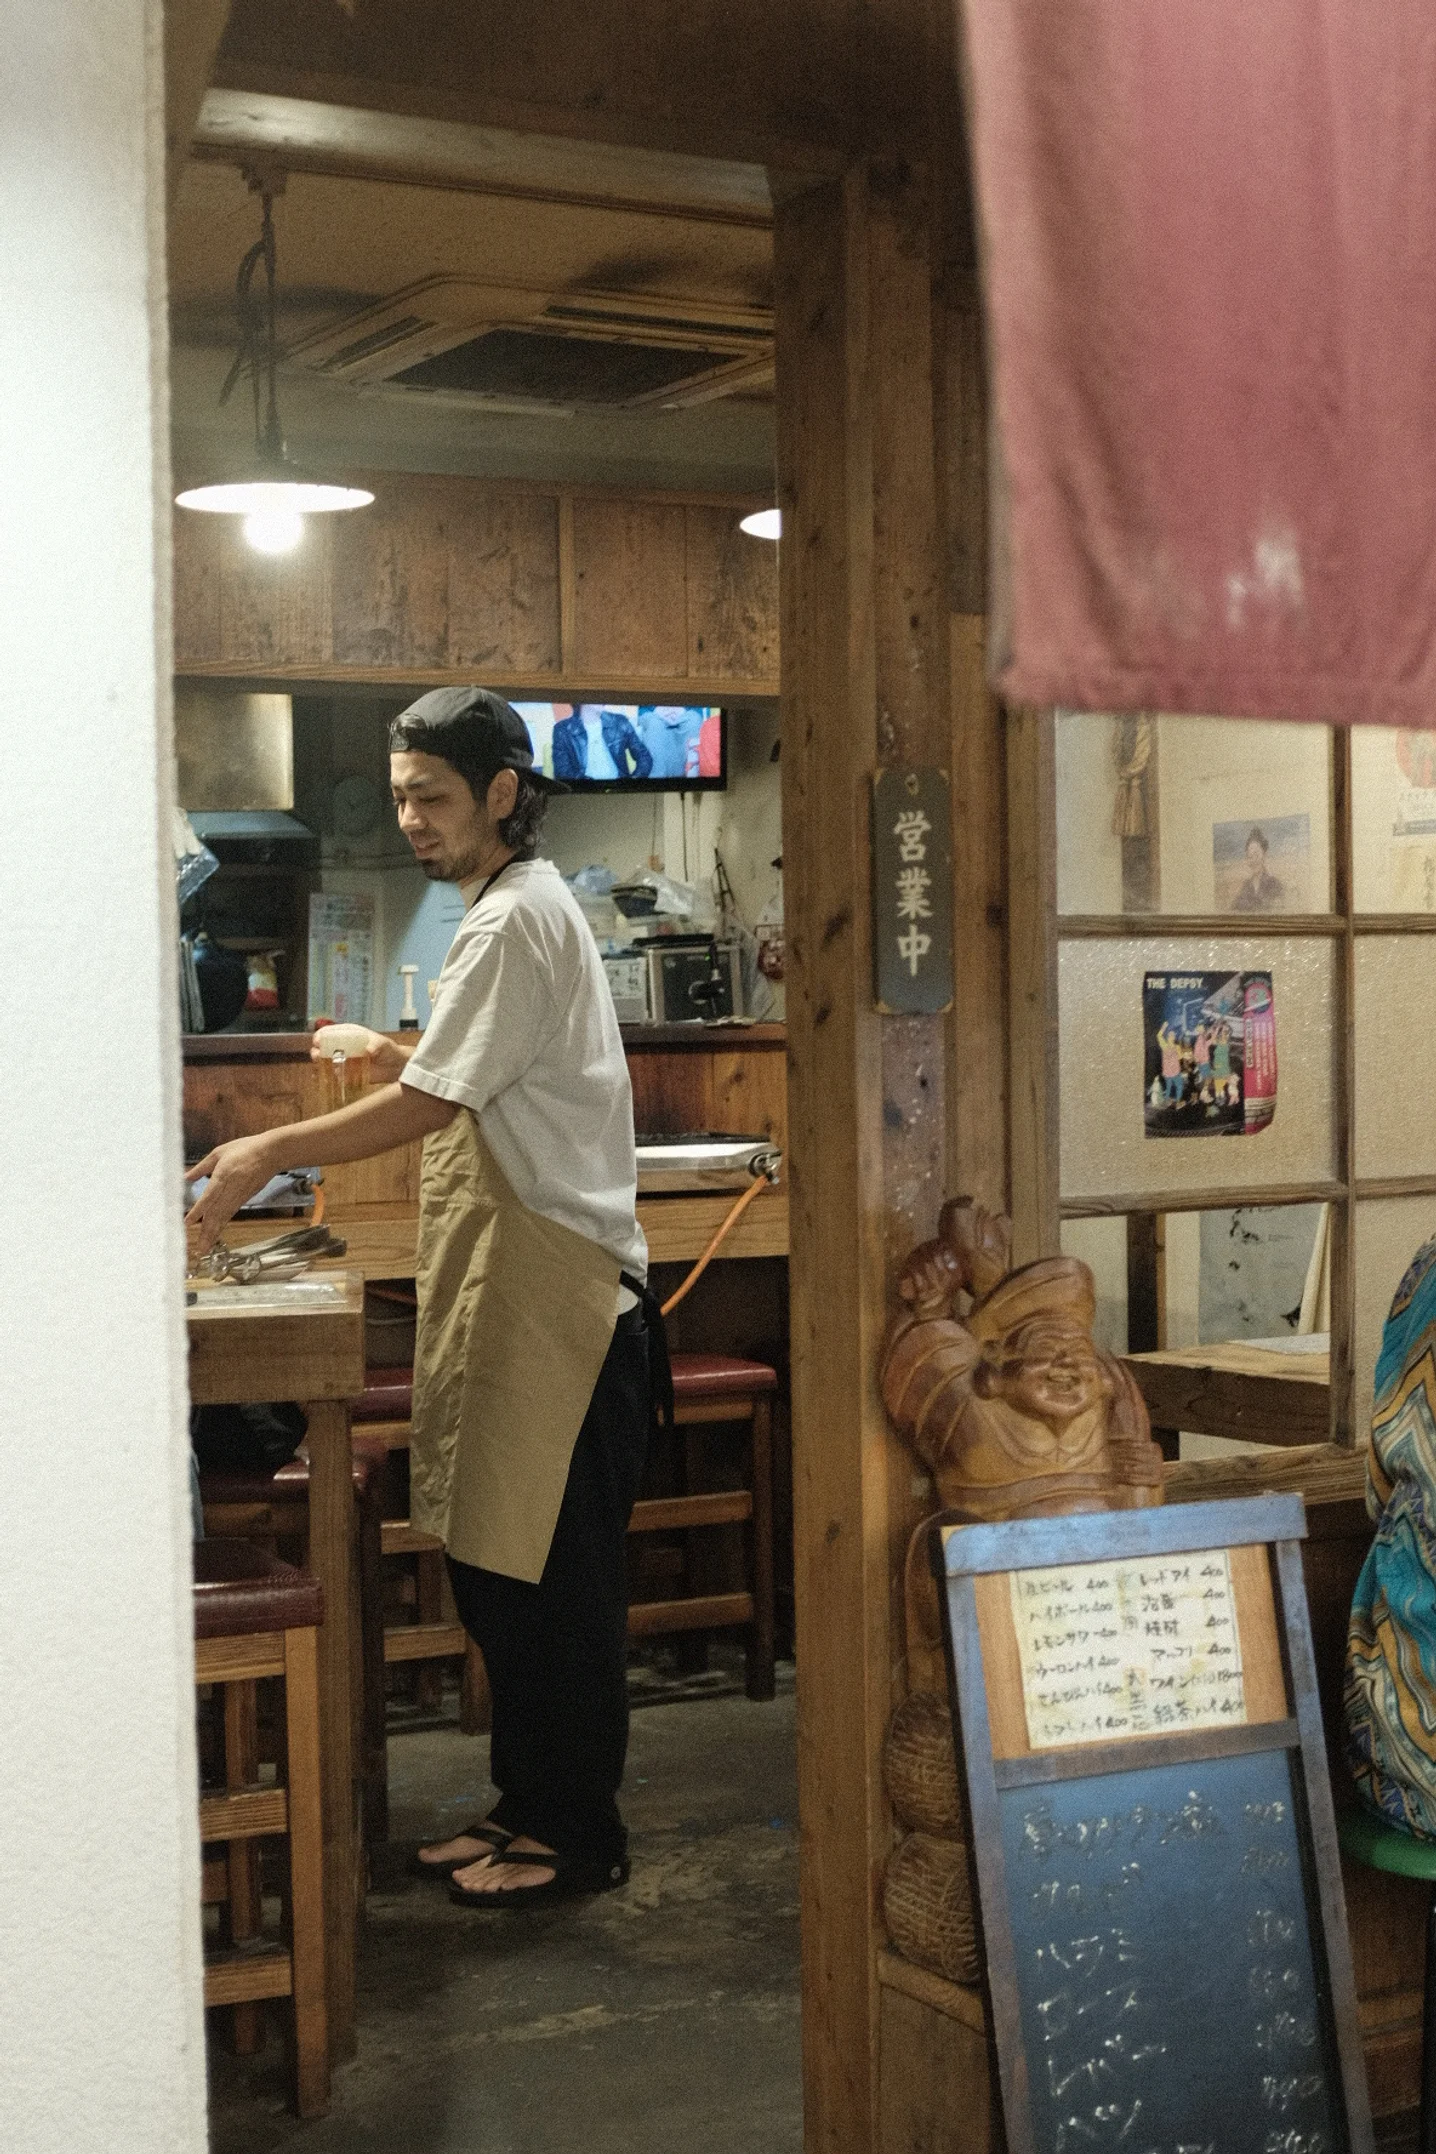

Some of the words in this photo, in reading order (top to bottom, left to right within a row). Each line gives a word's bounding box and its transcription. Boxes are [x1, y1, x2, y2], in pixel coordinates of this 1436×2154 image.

[893, 810, 934, 977] 営業中
[1146, 977, 1166, 990] THE
[1030, 1602, 1090, 1623] ハイボール
[1033, 1628, 1101, 1652] レモンサワー
